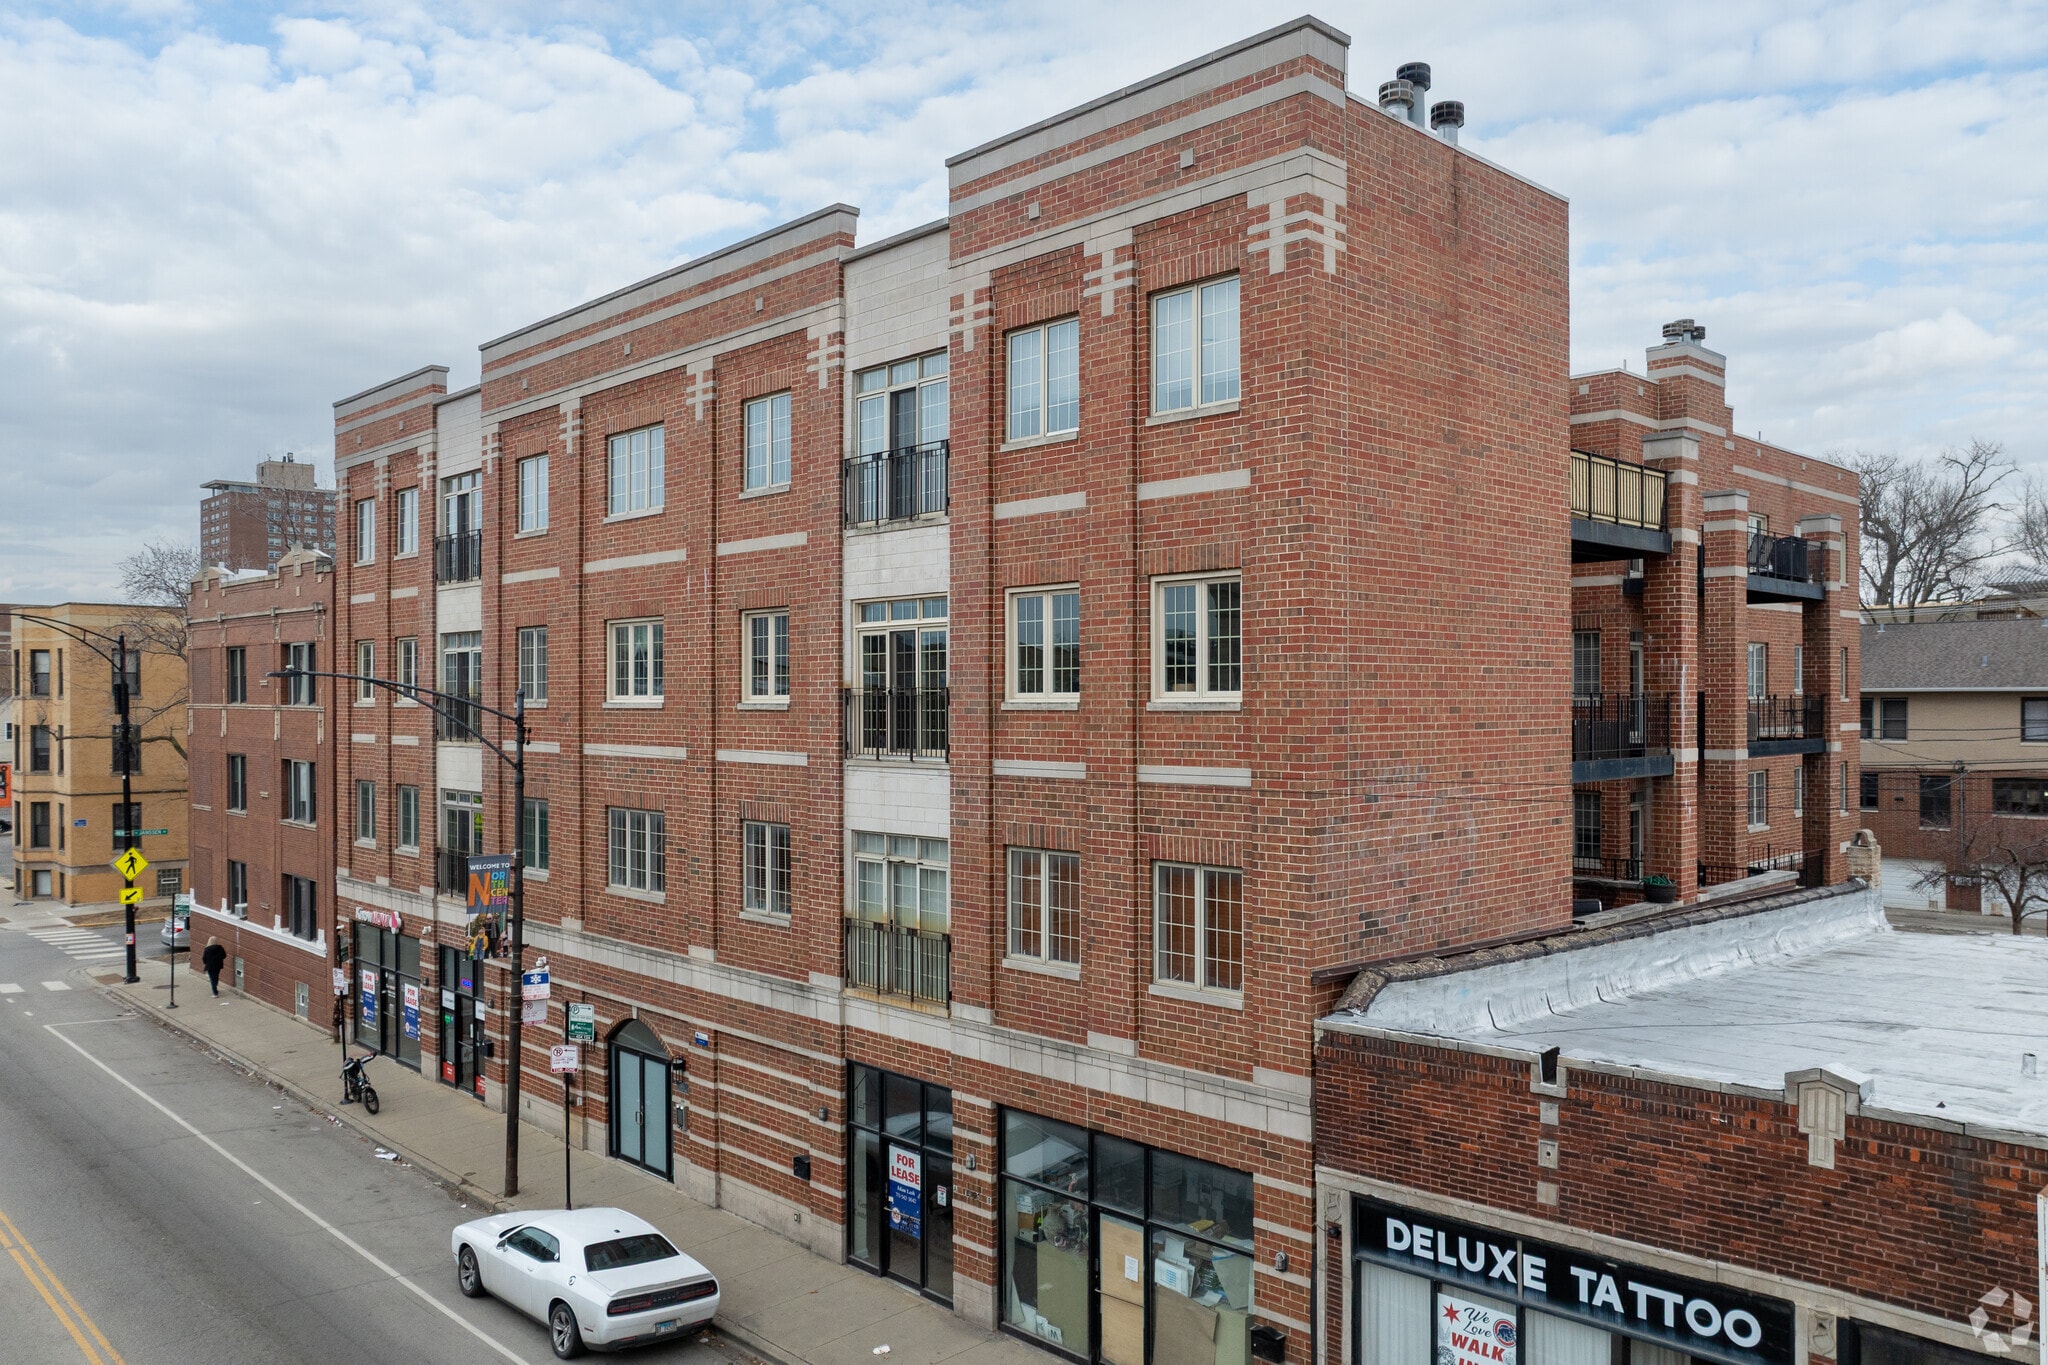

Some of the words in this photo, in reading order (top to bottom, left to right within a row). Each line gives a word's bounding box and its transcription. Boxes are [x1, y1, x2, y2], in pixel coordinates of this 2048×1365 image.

[470, 863, 500, 871] WELCOME
[492, 880, 505, 889] TH
[491, 888, 509, 897] CEN
[491, 897, 508, 905] TER
[365, 973, 373, 982] FOR
[363, 983, 374, 992] LEASE
[407, 987, 415, 996] FOR
[405, 996, 417, 1007] LEASE
[896, 1153, 915, 1169] FOR
[891, 1165, 920, 1186] LEASE
[1386, 1217, 1547, 1293] DELUXE
[1570, 1265, 1762, 1348] TATTOO
[1464, 1307, 1491, 1324] We
[1463, 1320, 1492, 1338] Love
[1451, 1332, 1506, 1363] WALK
